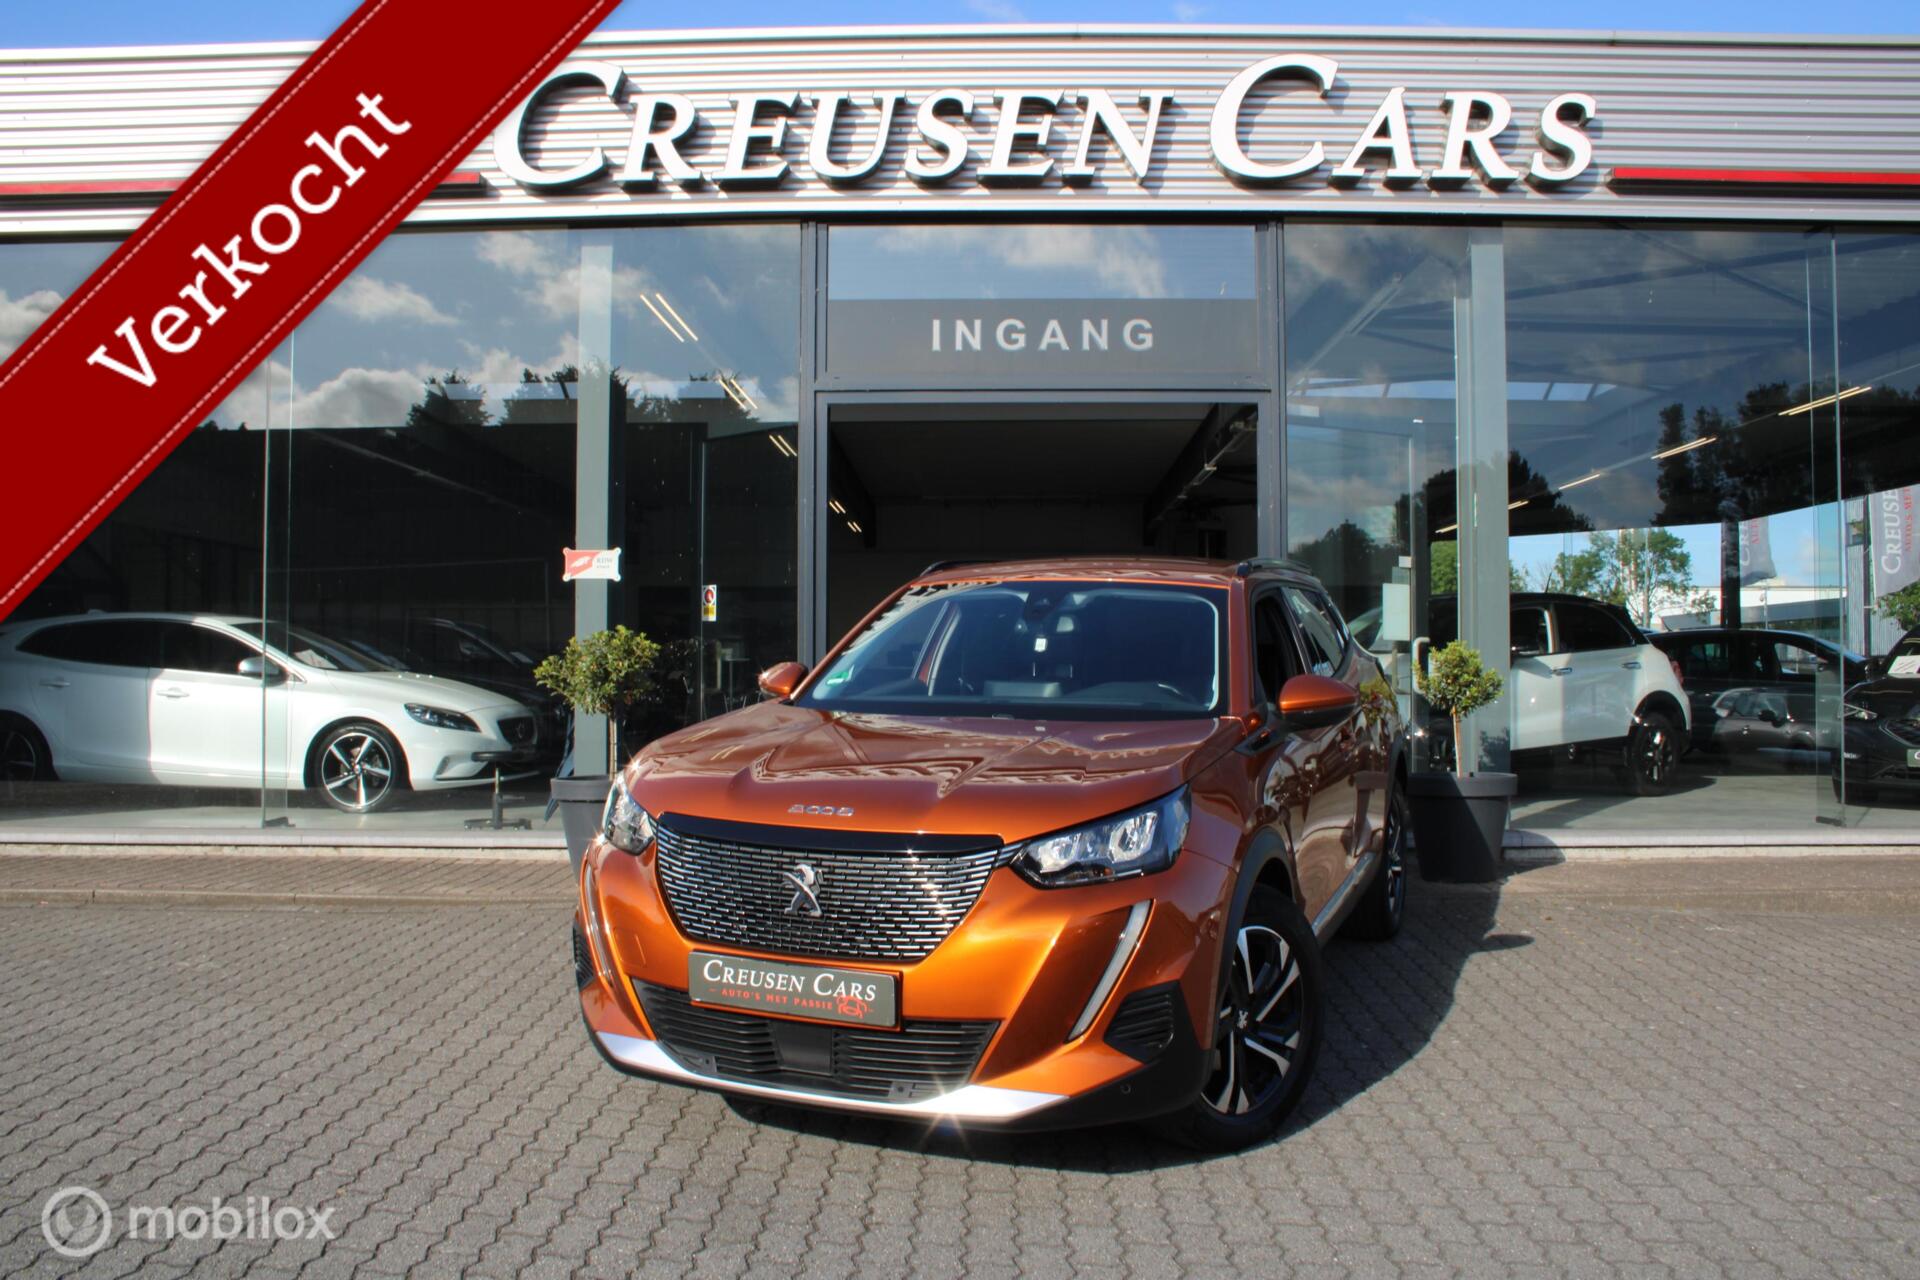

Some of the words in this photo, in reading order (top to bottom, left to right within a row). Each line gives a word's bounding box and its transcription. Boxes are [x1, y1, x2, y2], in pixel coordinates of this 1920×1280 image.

[493, 60, 1174, 190] CREUSEN
[1208, 52, 1597, 186] CARS
[931, 318, 1154, 351] INGANG
[703, 959, 805, 993] CREUSEN
[813, 973, 876, 1001] CARS
